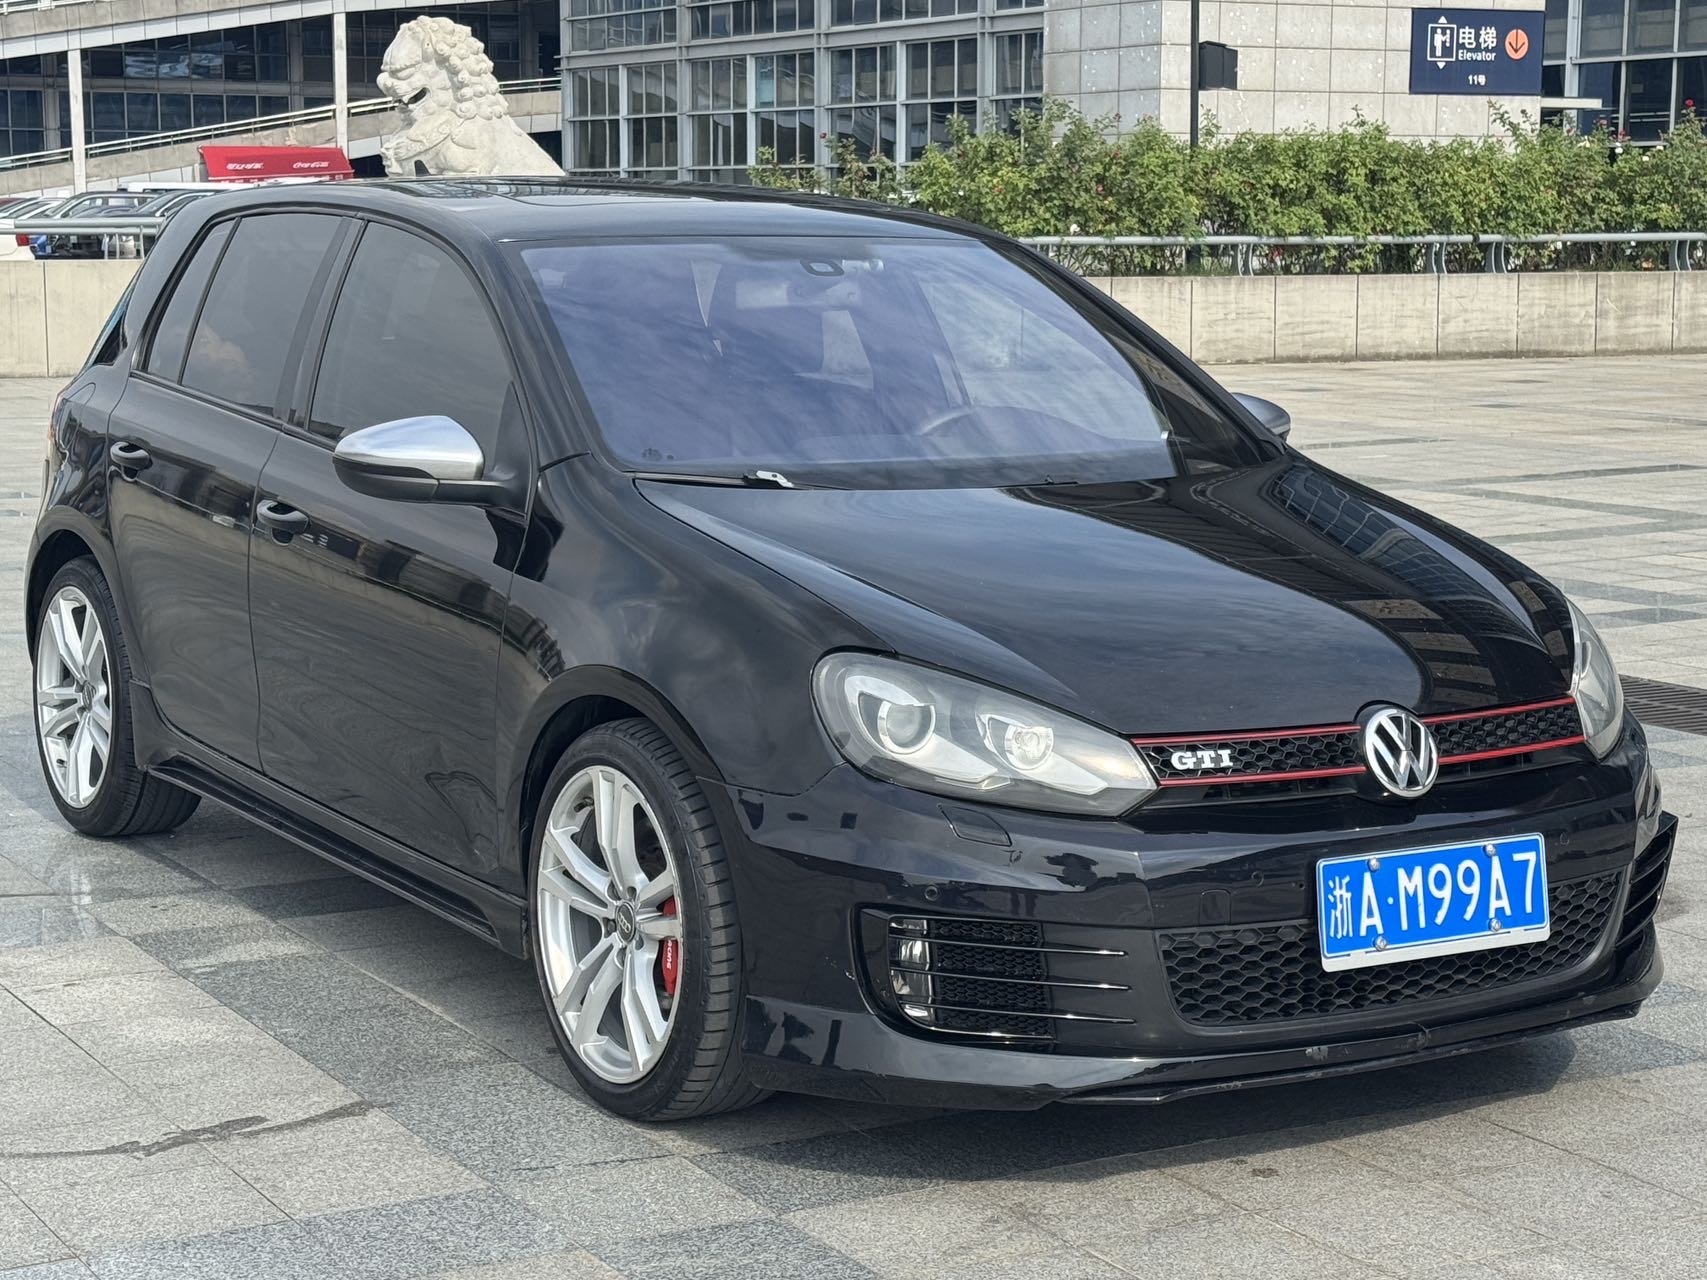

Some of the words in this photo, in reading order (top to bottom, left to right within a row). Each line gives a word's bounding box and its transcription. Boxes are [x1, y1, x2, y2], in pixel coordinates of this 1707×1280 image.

[1459, 26, 1497, 49] 电梯
[1458, 50, 1496, 61] Elevator
[1468, 74, 1486, 86] 11号
[1170, 749, 1234, 771] GTI
